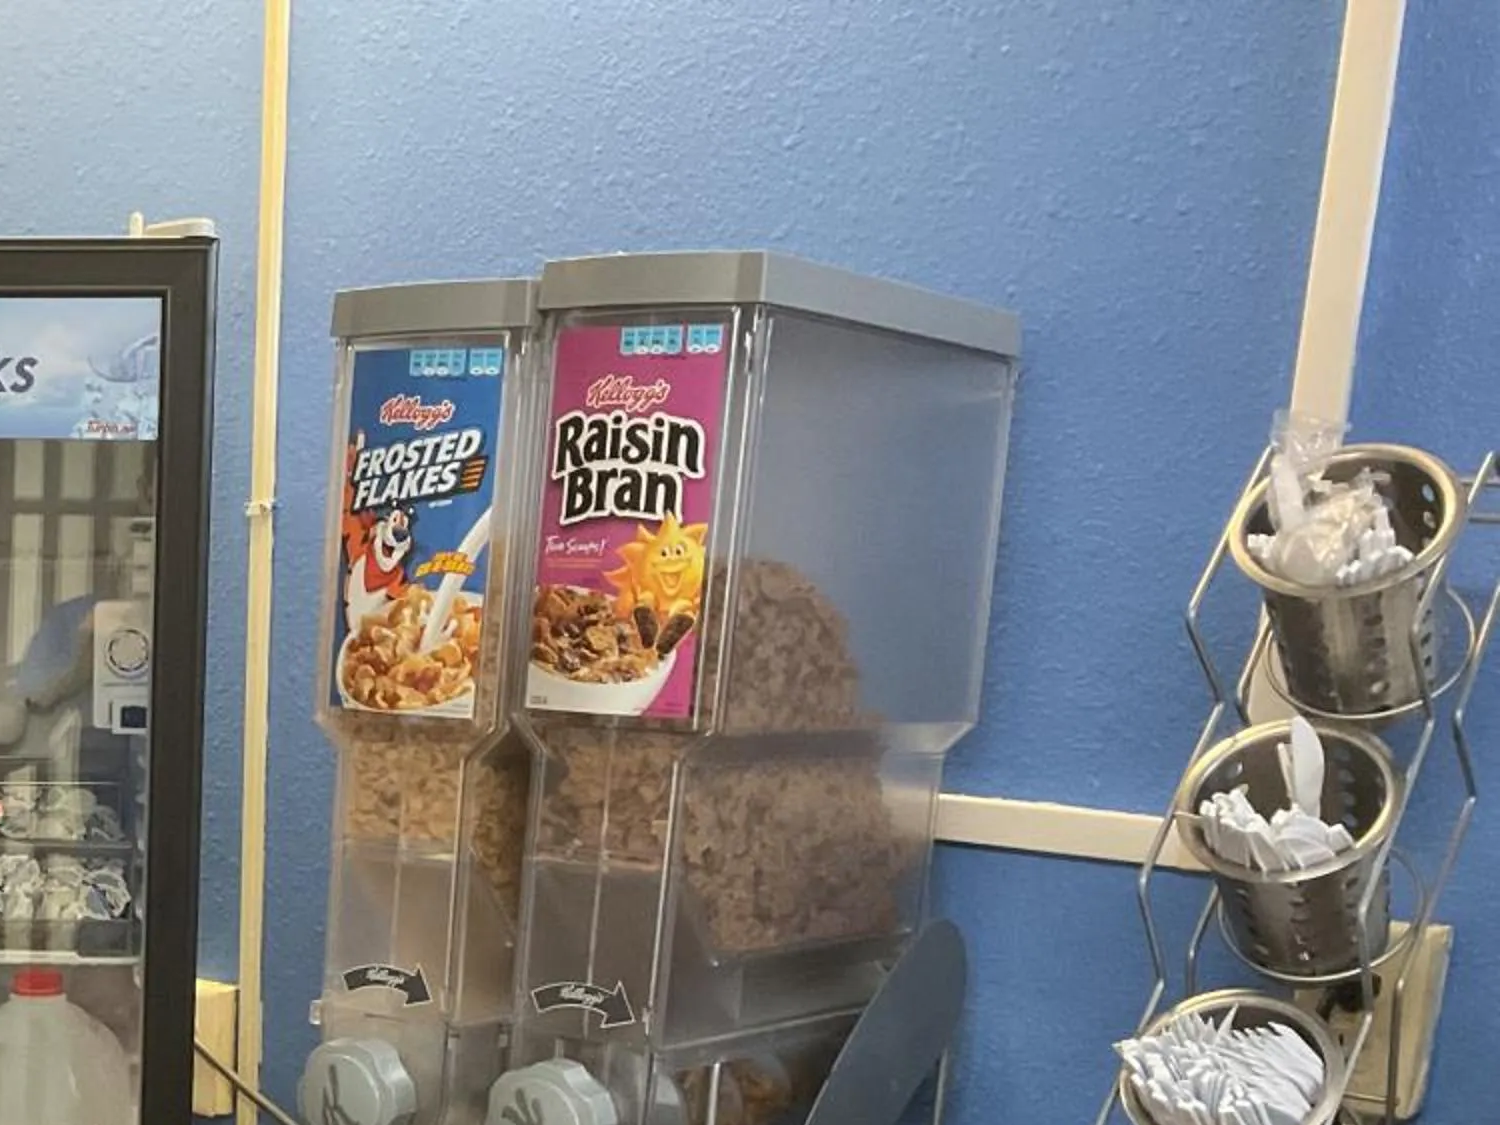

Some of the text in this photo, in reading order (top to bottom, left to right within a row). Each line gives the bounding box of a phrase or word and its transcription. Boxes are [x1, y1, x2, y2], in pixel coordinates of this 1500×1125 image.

[379, 394, 456, 430] Kellogg's
[586, 375, 670, 412] Kellogg's
[354, 429, 482, 482] FROSTED
[555, 412, 702, 474] Raisin
[354, 461, 460, 509] FLAKES
[564, 467, 679, 520] Bran
